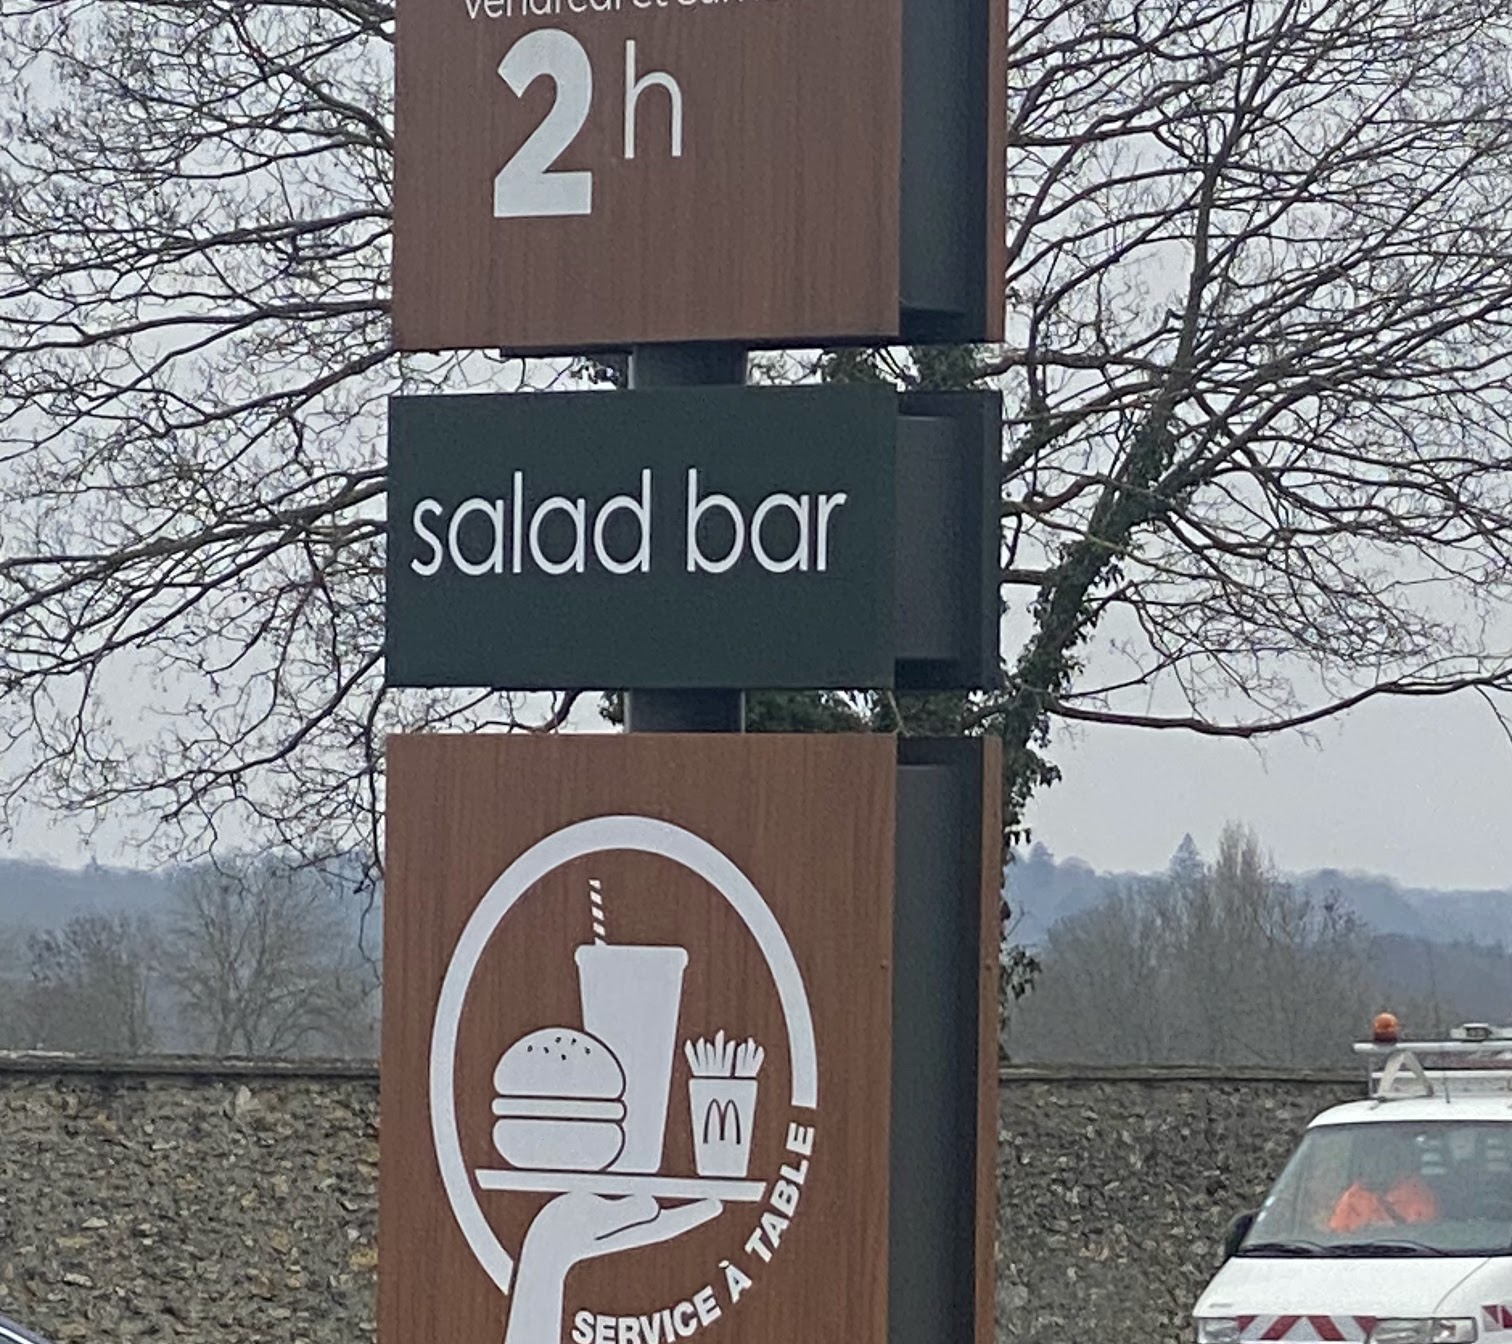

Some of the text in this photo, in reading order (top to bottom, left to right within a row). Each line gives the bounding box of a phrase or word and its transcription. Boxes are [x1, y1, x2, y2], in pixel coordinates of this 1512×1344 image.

[493, 28, 683, 218] 2 h
[411, 468, 848, 576] salad bar
[718, 1260, 753, 1304] À
[744, 1122, 815, 1263] TABLE
